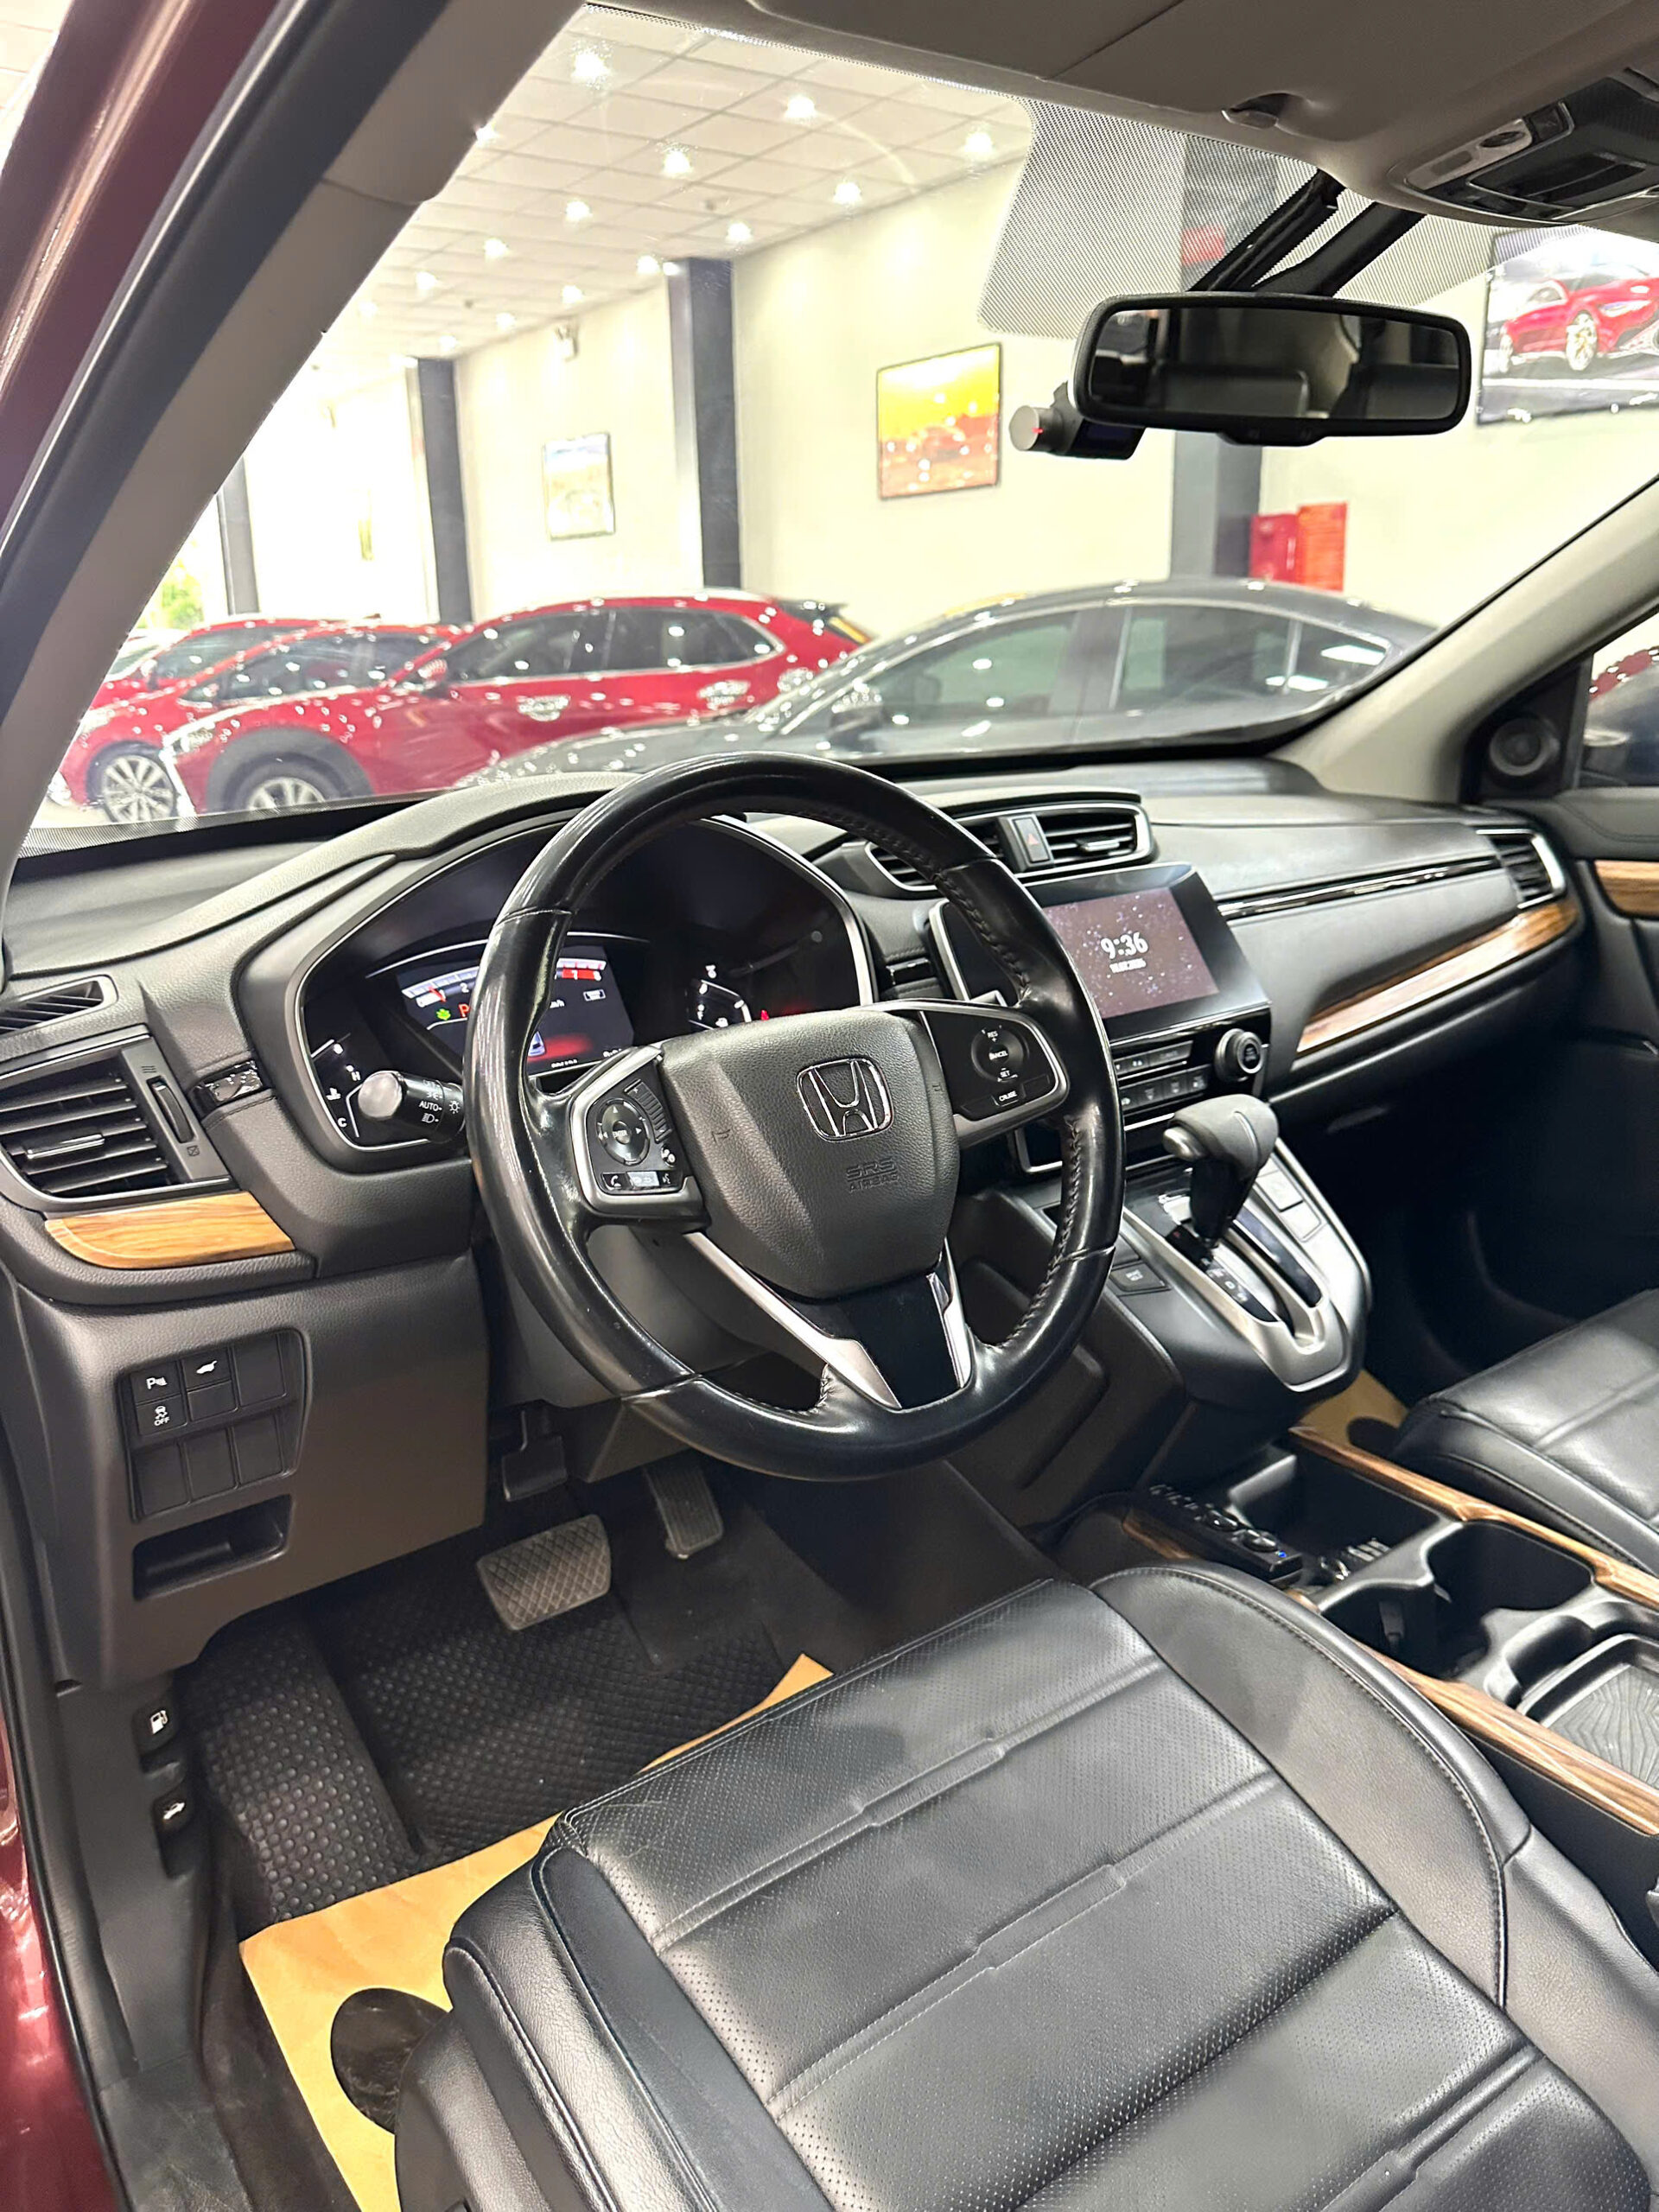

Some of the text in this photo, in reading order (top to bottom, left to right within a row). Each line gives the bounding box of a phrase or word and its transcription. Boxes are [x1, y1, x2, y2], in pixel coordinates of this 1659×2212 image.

[1100, 931, 1149, 959] 9:36
[460, 982, 470, 993] 2
[351, 1071, 361, 1082] H
[418, 1100, 439, 1112] AUTO
[337, 1117, 347, 1128] C
[846, 1157, 896, 1179] SRS
[154, 1417, 170, 1427] OFF
